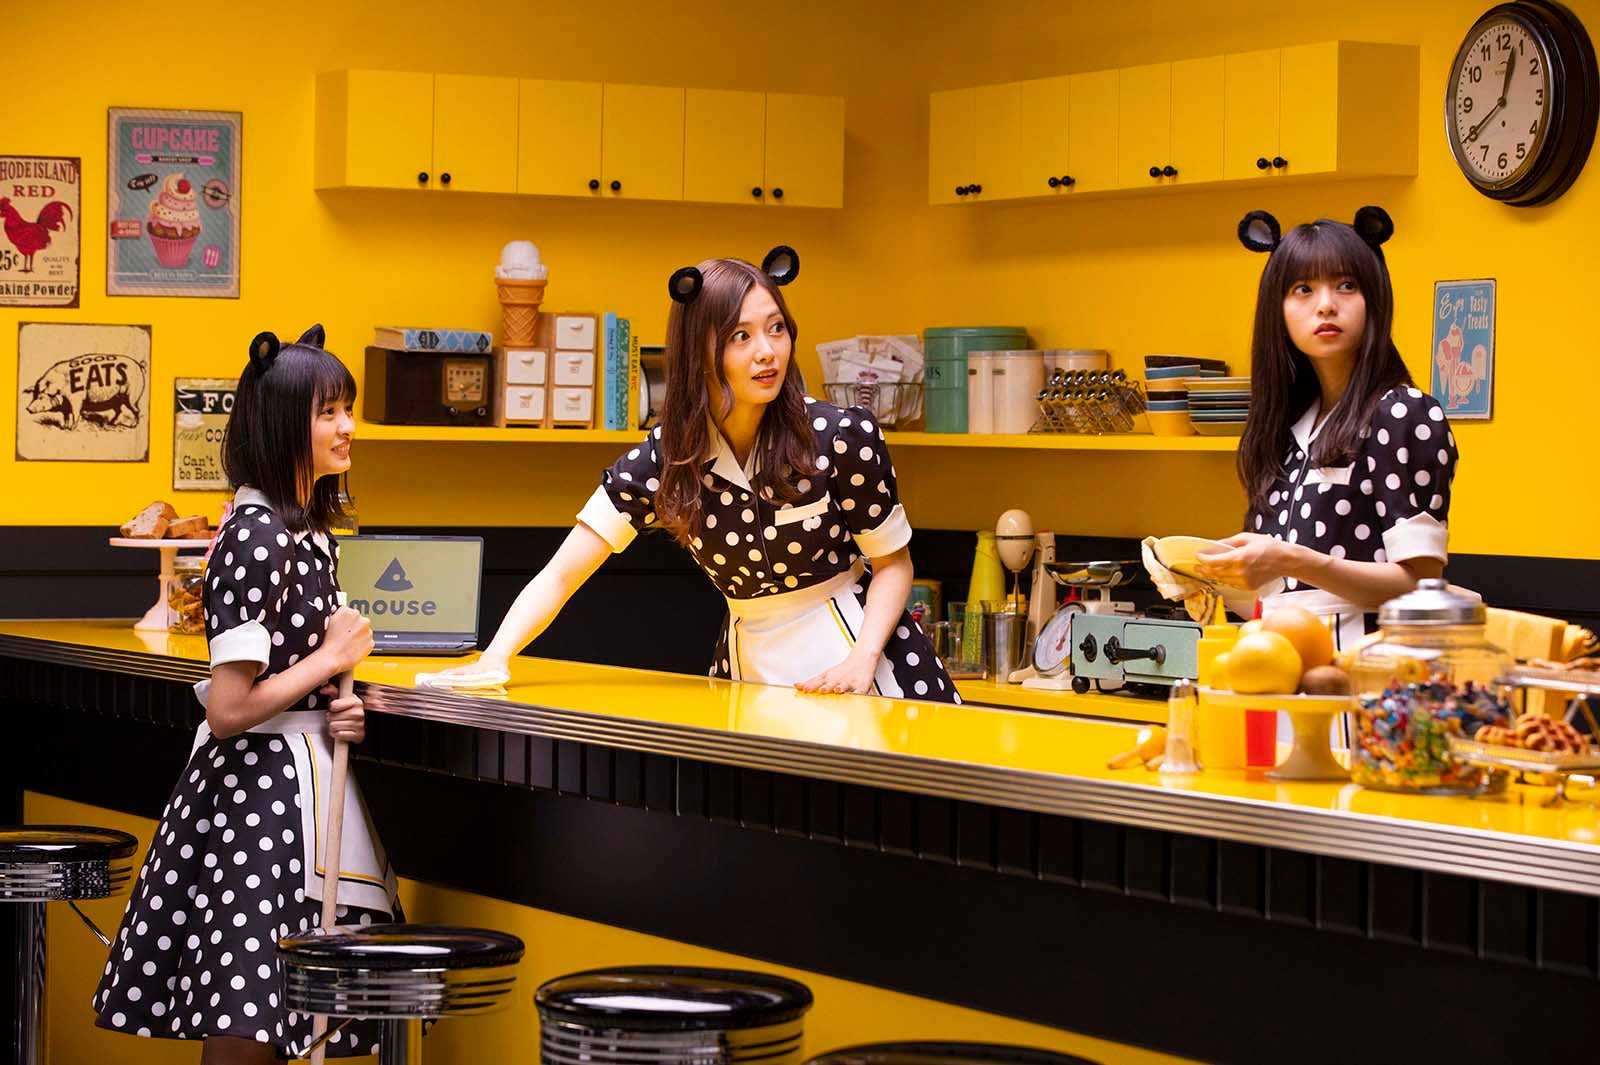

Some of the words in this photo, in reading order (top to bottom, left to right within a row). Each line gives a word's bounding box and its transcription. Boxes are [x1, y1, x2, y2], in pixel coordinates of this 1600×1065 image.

[1495, 33, 1511, 51] 12
[1518, 39, 1524, 56] 1
[1480, 44, 1491, 62] 11
[1468, 66, 1482, 83] 10
[1529, 58, 1539, 75] 2
[1463, 97, 1473, 113] 9
[1535, 89, 1543, 106] 3
[1469, 125, 1479, 142] 8
[1529, 119, 1538, 137] 4
[131, 127, 219, 152] CUPCAKE
[1480, 145, 1490, 162] 7
[1516, 142, 1526, 160] 5
[1497, 152, 1507, 169] 6
[33, 162, 76, 184] ISLAND
[13, 185, 55, 197] RED
[33, 283, 76, 296] Powder
[631, 335, 639, 359] MUST
[69, 355, 117, 368] GOOD
[69, 363, 128, 394] EATS
[205, 428, 226, 442] CO
[183, 455, 214, 467] Can't
[179, 467, 191, 479] be
[195, 467, 220, 480] Beat
[349, 599, 437, 616] mouse
